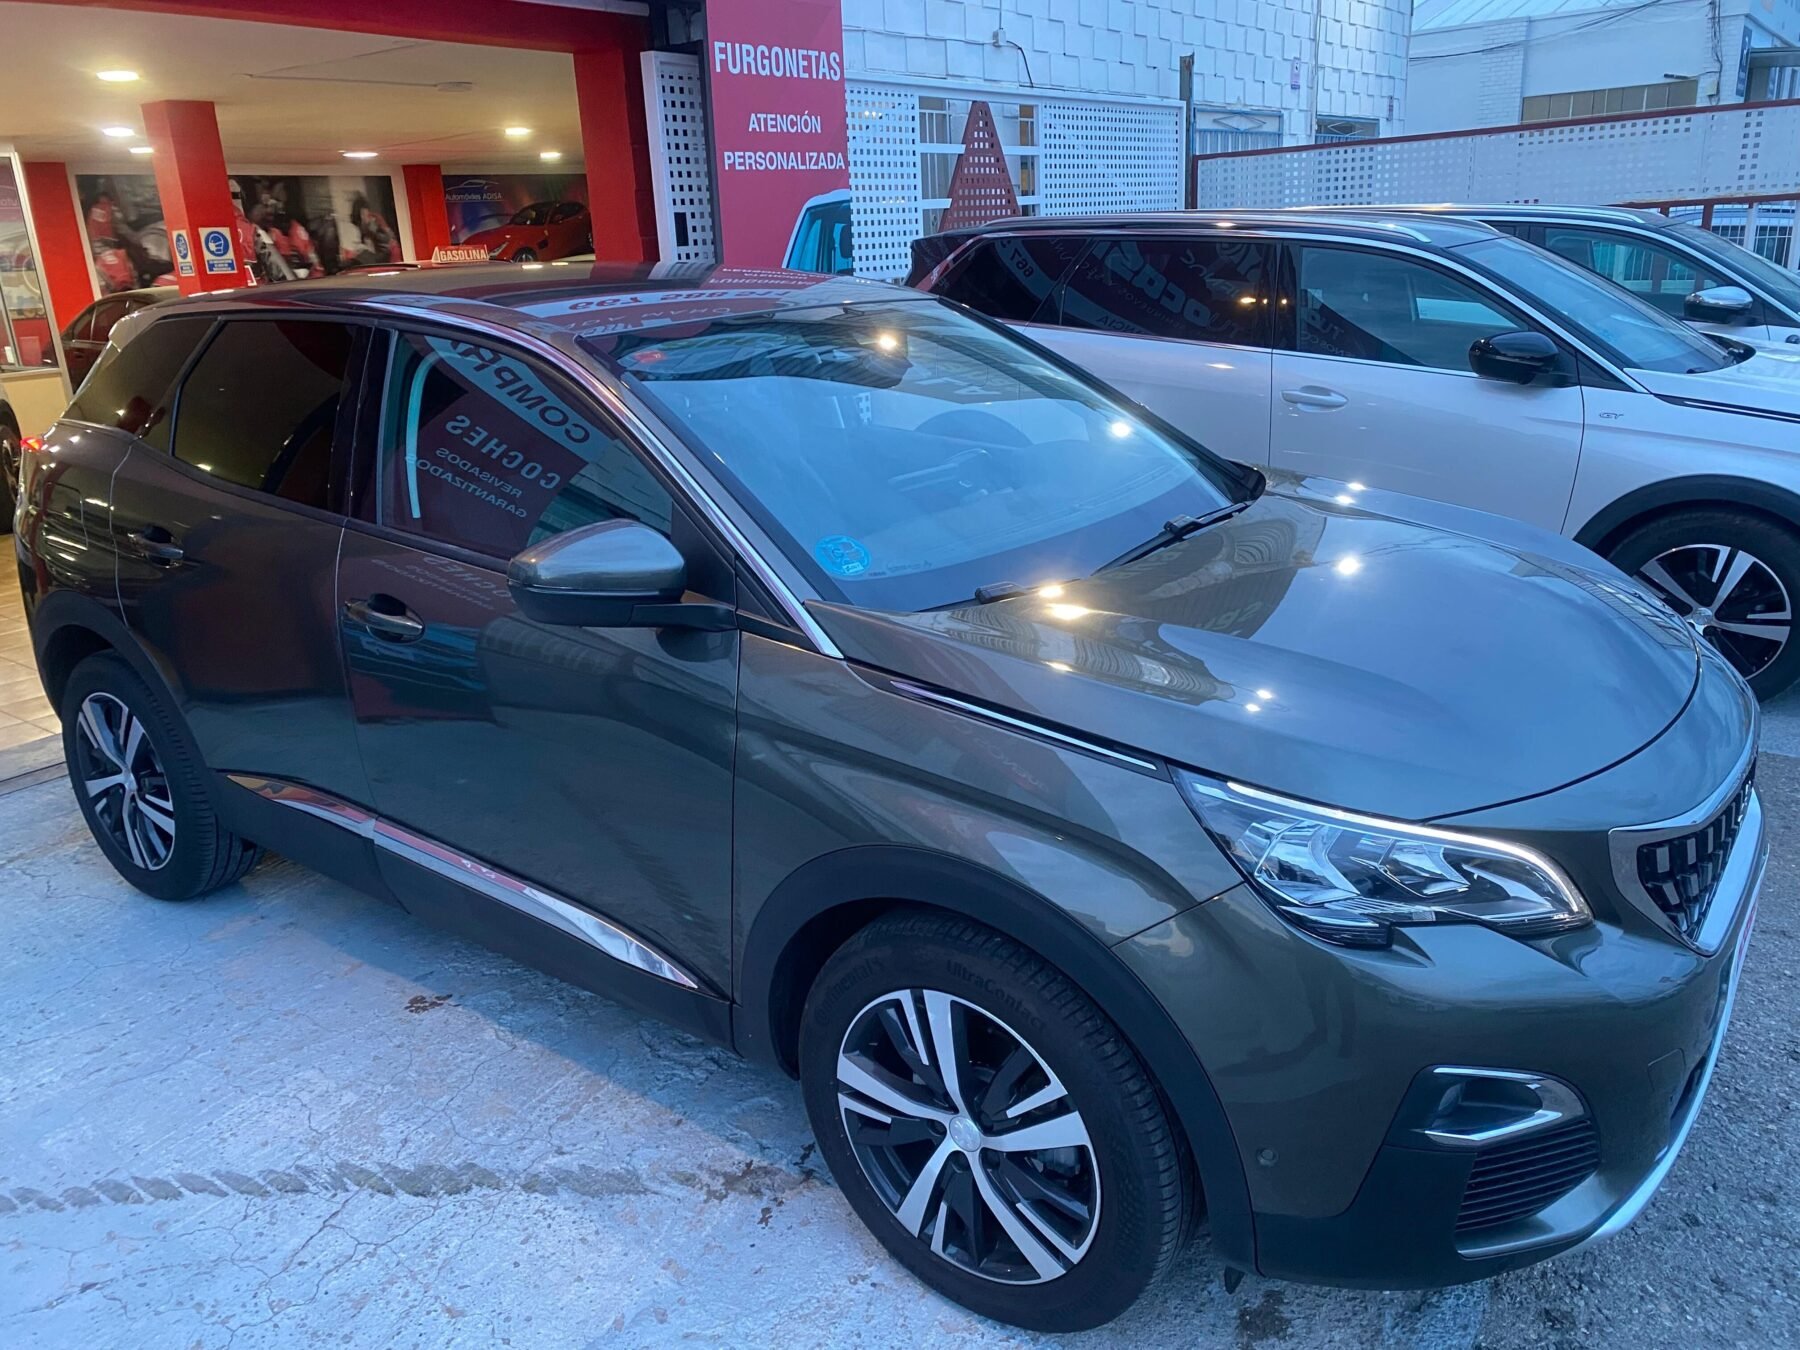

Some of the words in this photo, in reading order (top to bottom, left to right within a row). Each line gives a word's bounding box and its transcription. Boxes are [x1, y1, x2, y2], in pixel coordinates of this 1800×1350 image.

[714, 41, 841, 81] FURGONETAS
[748, 110, 821, 133] ATENCIÓN
[723, 151, 845, 170] PERSONALIZADA
[439, 248, 487, 261] GASOLINA
